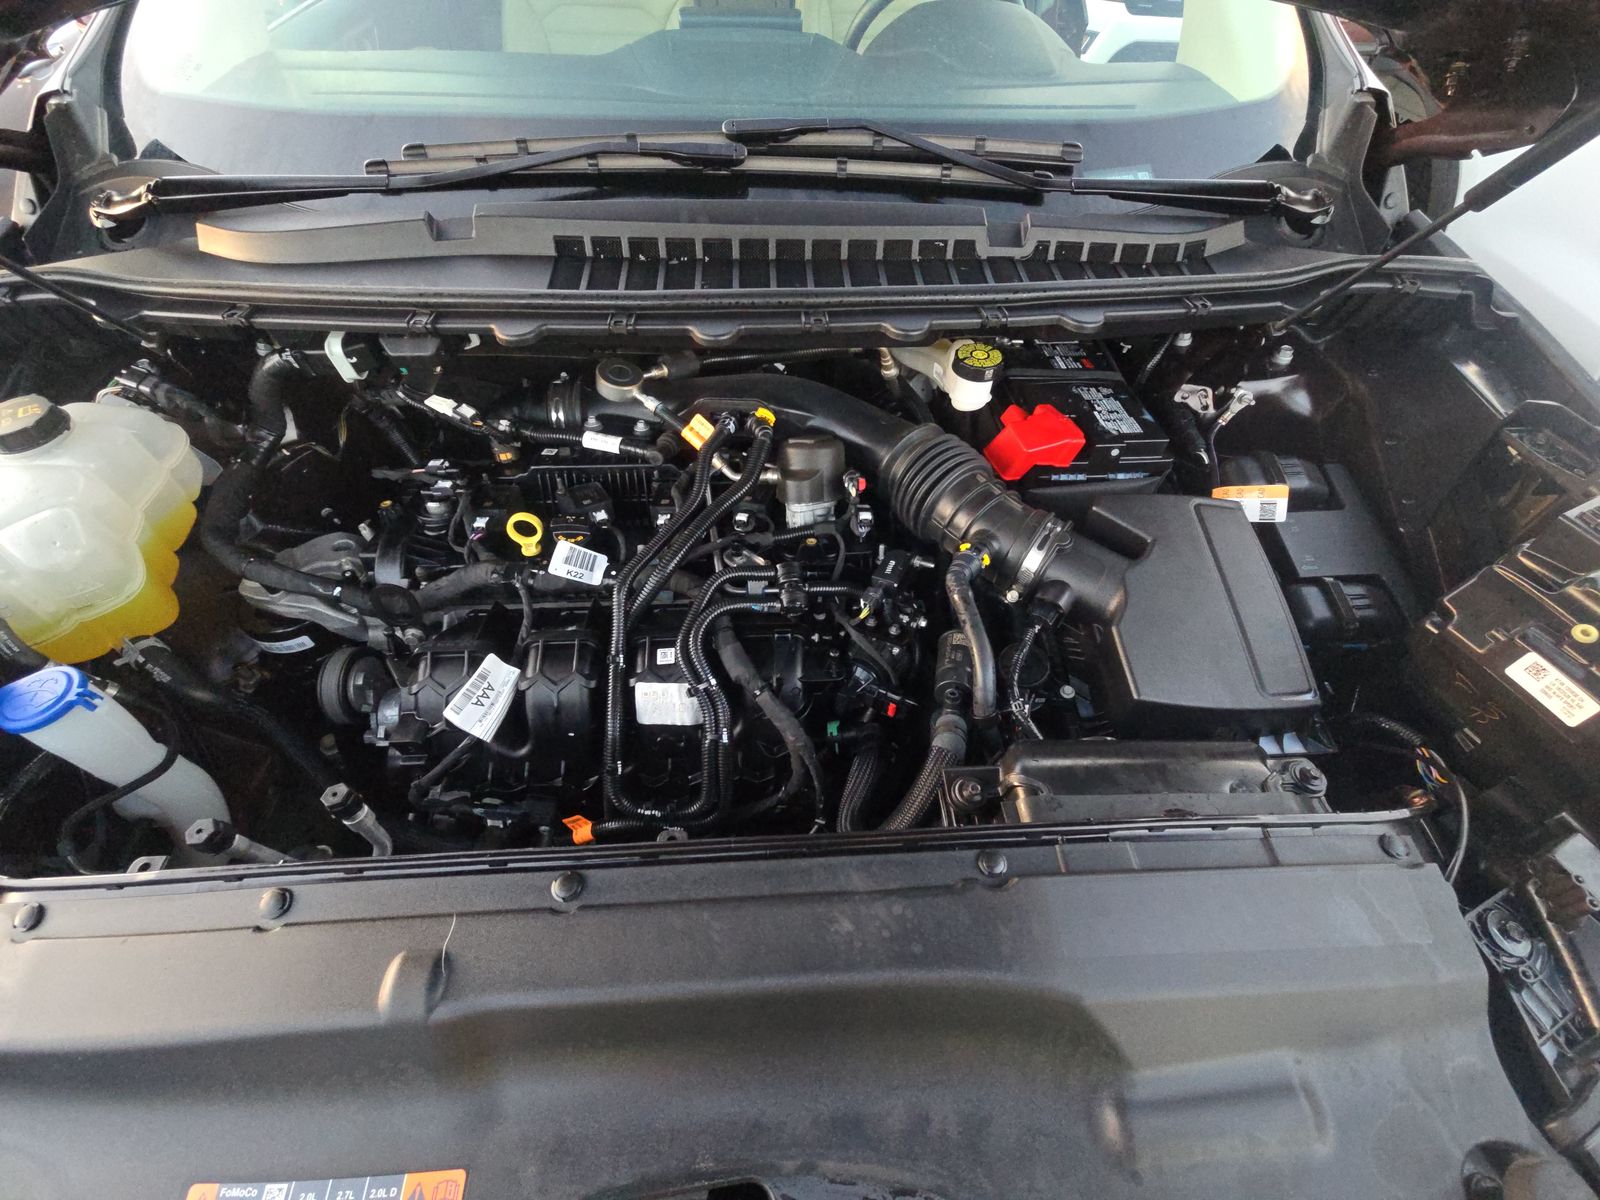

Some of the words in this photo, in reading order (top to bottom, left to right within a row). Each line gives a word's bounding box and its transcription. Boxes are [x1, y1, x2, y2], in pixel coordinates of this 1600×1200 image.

[566, 569, 585, 580] K22
[471, 681, 495, 707] AAA
[219, 1186, 258, 1198] FoMoCo
[336, 1190, 355, 1200] 2.7L
[369, 1187, 388, 1199] 2.0L
[389, 1187, 398, 1197] D
